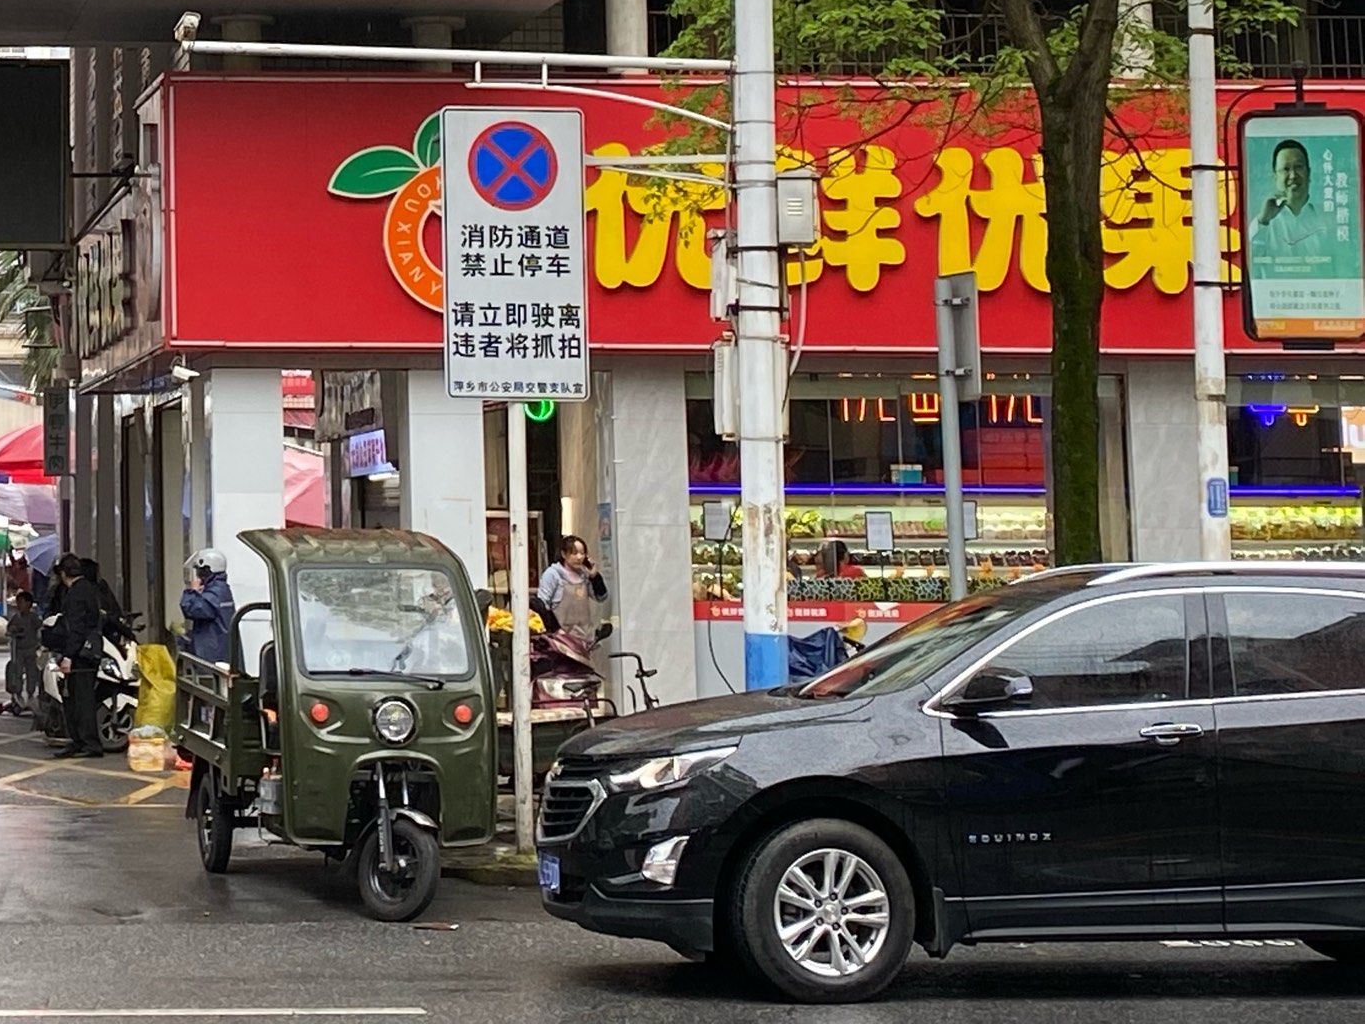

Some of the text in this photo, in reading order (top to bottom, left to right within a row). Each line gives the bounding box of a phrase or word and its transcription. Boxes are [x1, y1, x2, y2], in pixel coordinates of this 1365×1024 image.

[461, 224, 571, 249] 消防通道
[461, 253, 571, 277] 禁止停车
[452, 301, 581, 328] 请立即驶离
[452, 333, 582, 359] 违者将抓拍
[453, 380, 583, 394] 萍乡市公安局交警支队宣
[968, 832, 1051, 843] EQUINOX
